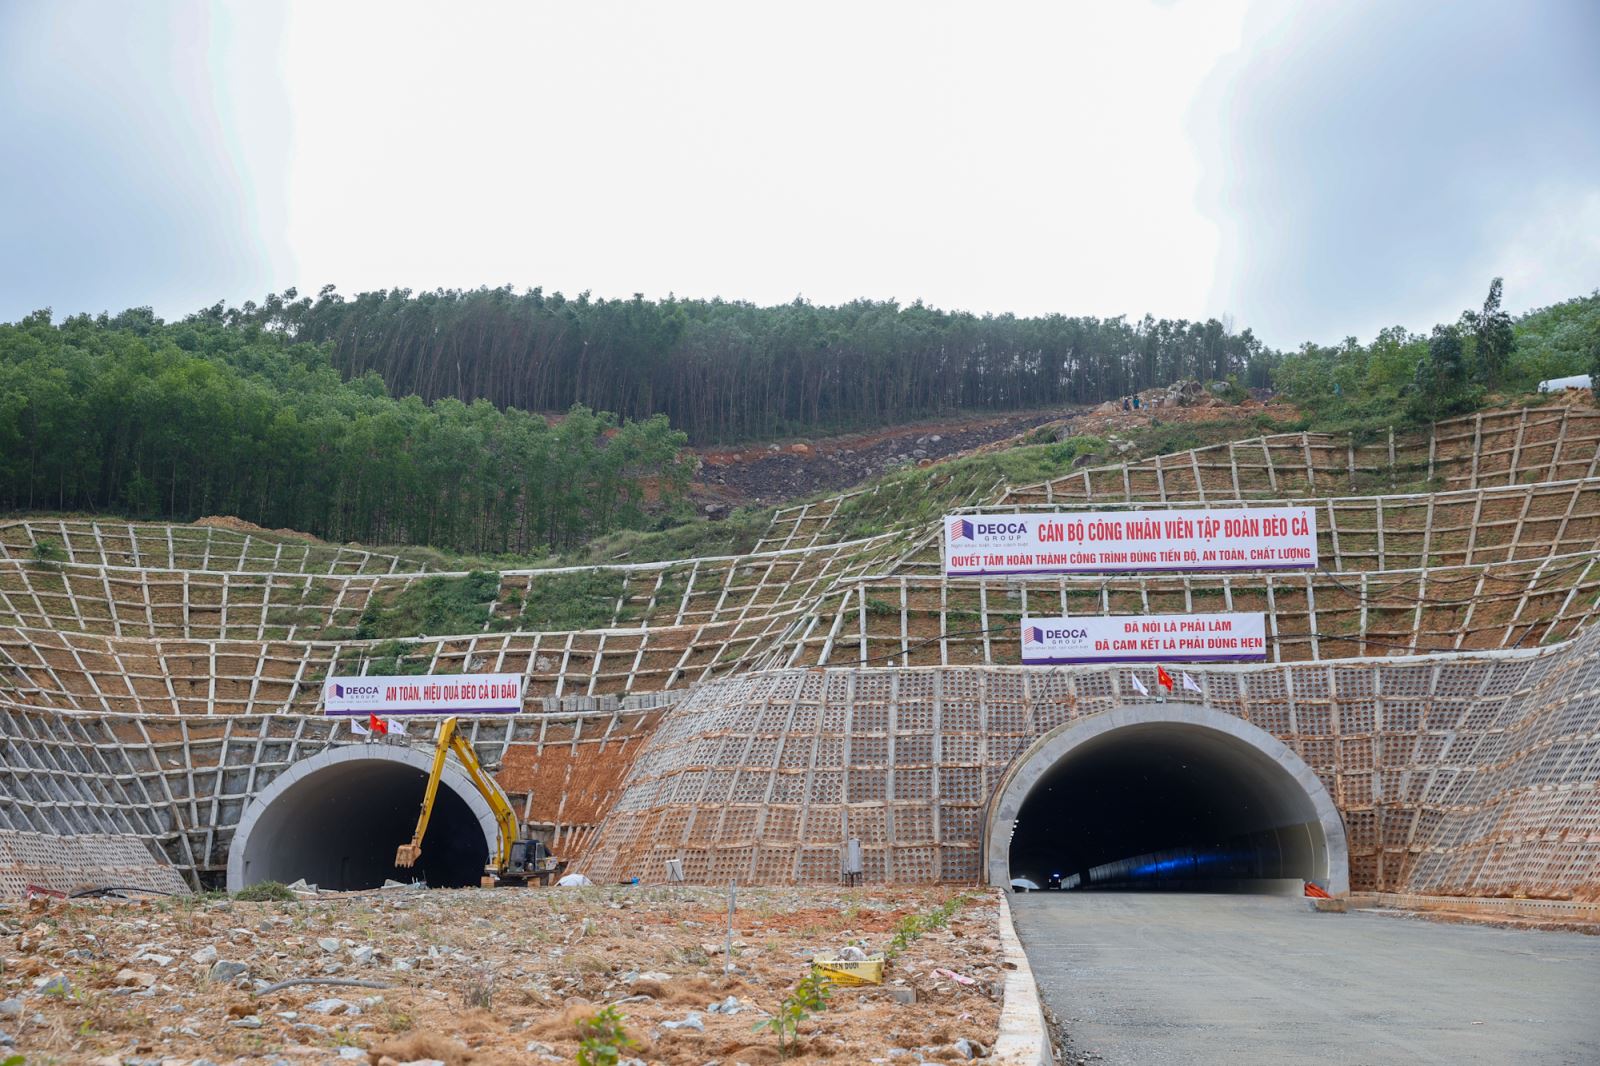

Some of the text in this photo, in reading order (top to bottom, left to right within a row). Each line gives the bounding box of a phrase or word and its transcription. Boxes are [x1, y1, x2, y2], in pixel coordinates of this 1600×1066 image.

[978, 523, 1027, 535] DEOCA
[1038, 511, 1309, 546] CÁN BỘ CÔNG NHÂN VIÊN TẬP ĐOÀN ĐÈO CẢ
[951, 553, 981, 567] QUYẾT
[984, 553, 1004, 566] TÂM
[1007, 552, 1033, 566] HOÀN
[1036, 552, 1067, 565] THÀNH
[1070, 551, 1096, 564] CÔNG
[1100, 550, 1128, 563] TRÌNH
[1130, 550, 1156, 563] ĐÚNG
[1159, 548, 1181, 562] TIẾN
[1202, 549, 1217, 561] AN
[1250, 545, 1276, 560] CHẤT
[1278, 547, 1311, 562] LƯỢNG
[1124, 621, 1139, 633] ĐÃ
[1164, 620, 1177, 632] LÀ
[1180, 618, 1205, 632] PHẢI
[1209, 619, 1232, 632] LÀM
[1046, 629, 1088, 639] DEOCA
[1095, 636, 1263, 651] ĐÃ CAM KẾT LÀ PHẢI ĐÚNG HẸN
[346, 686, 379, 695] DEOCA
[386, 687, 397, 701] AN
[424, 682, 441, 704] HIỆU
[444, 680, 459, 702] QUẢ
[461, 681, 477, 700] ĐÈO
[478, 680, 489, 699] CẢ
[491, 684, 499, 699] ĐI
